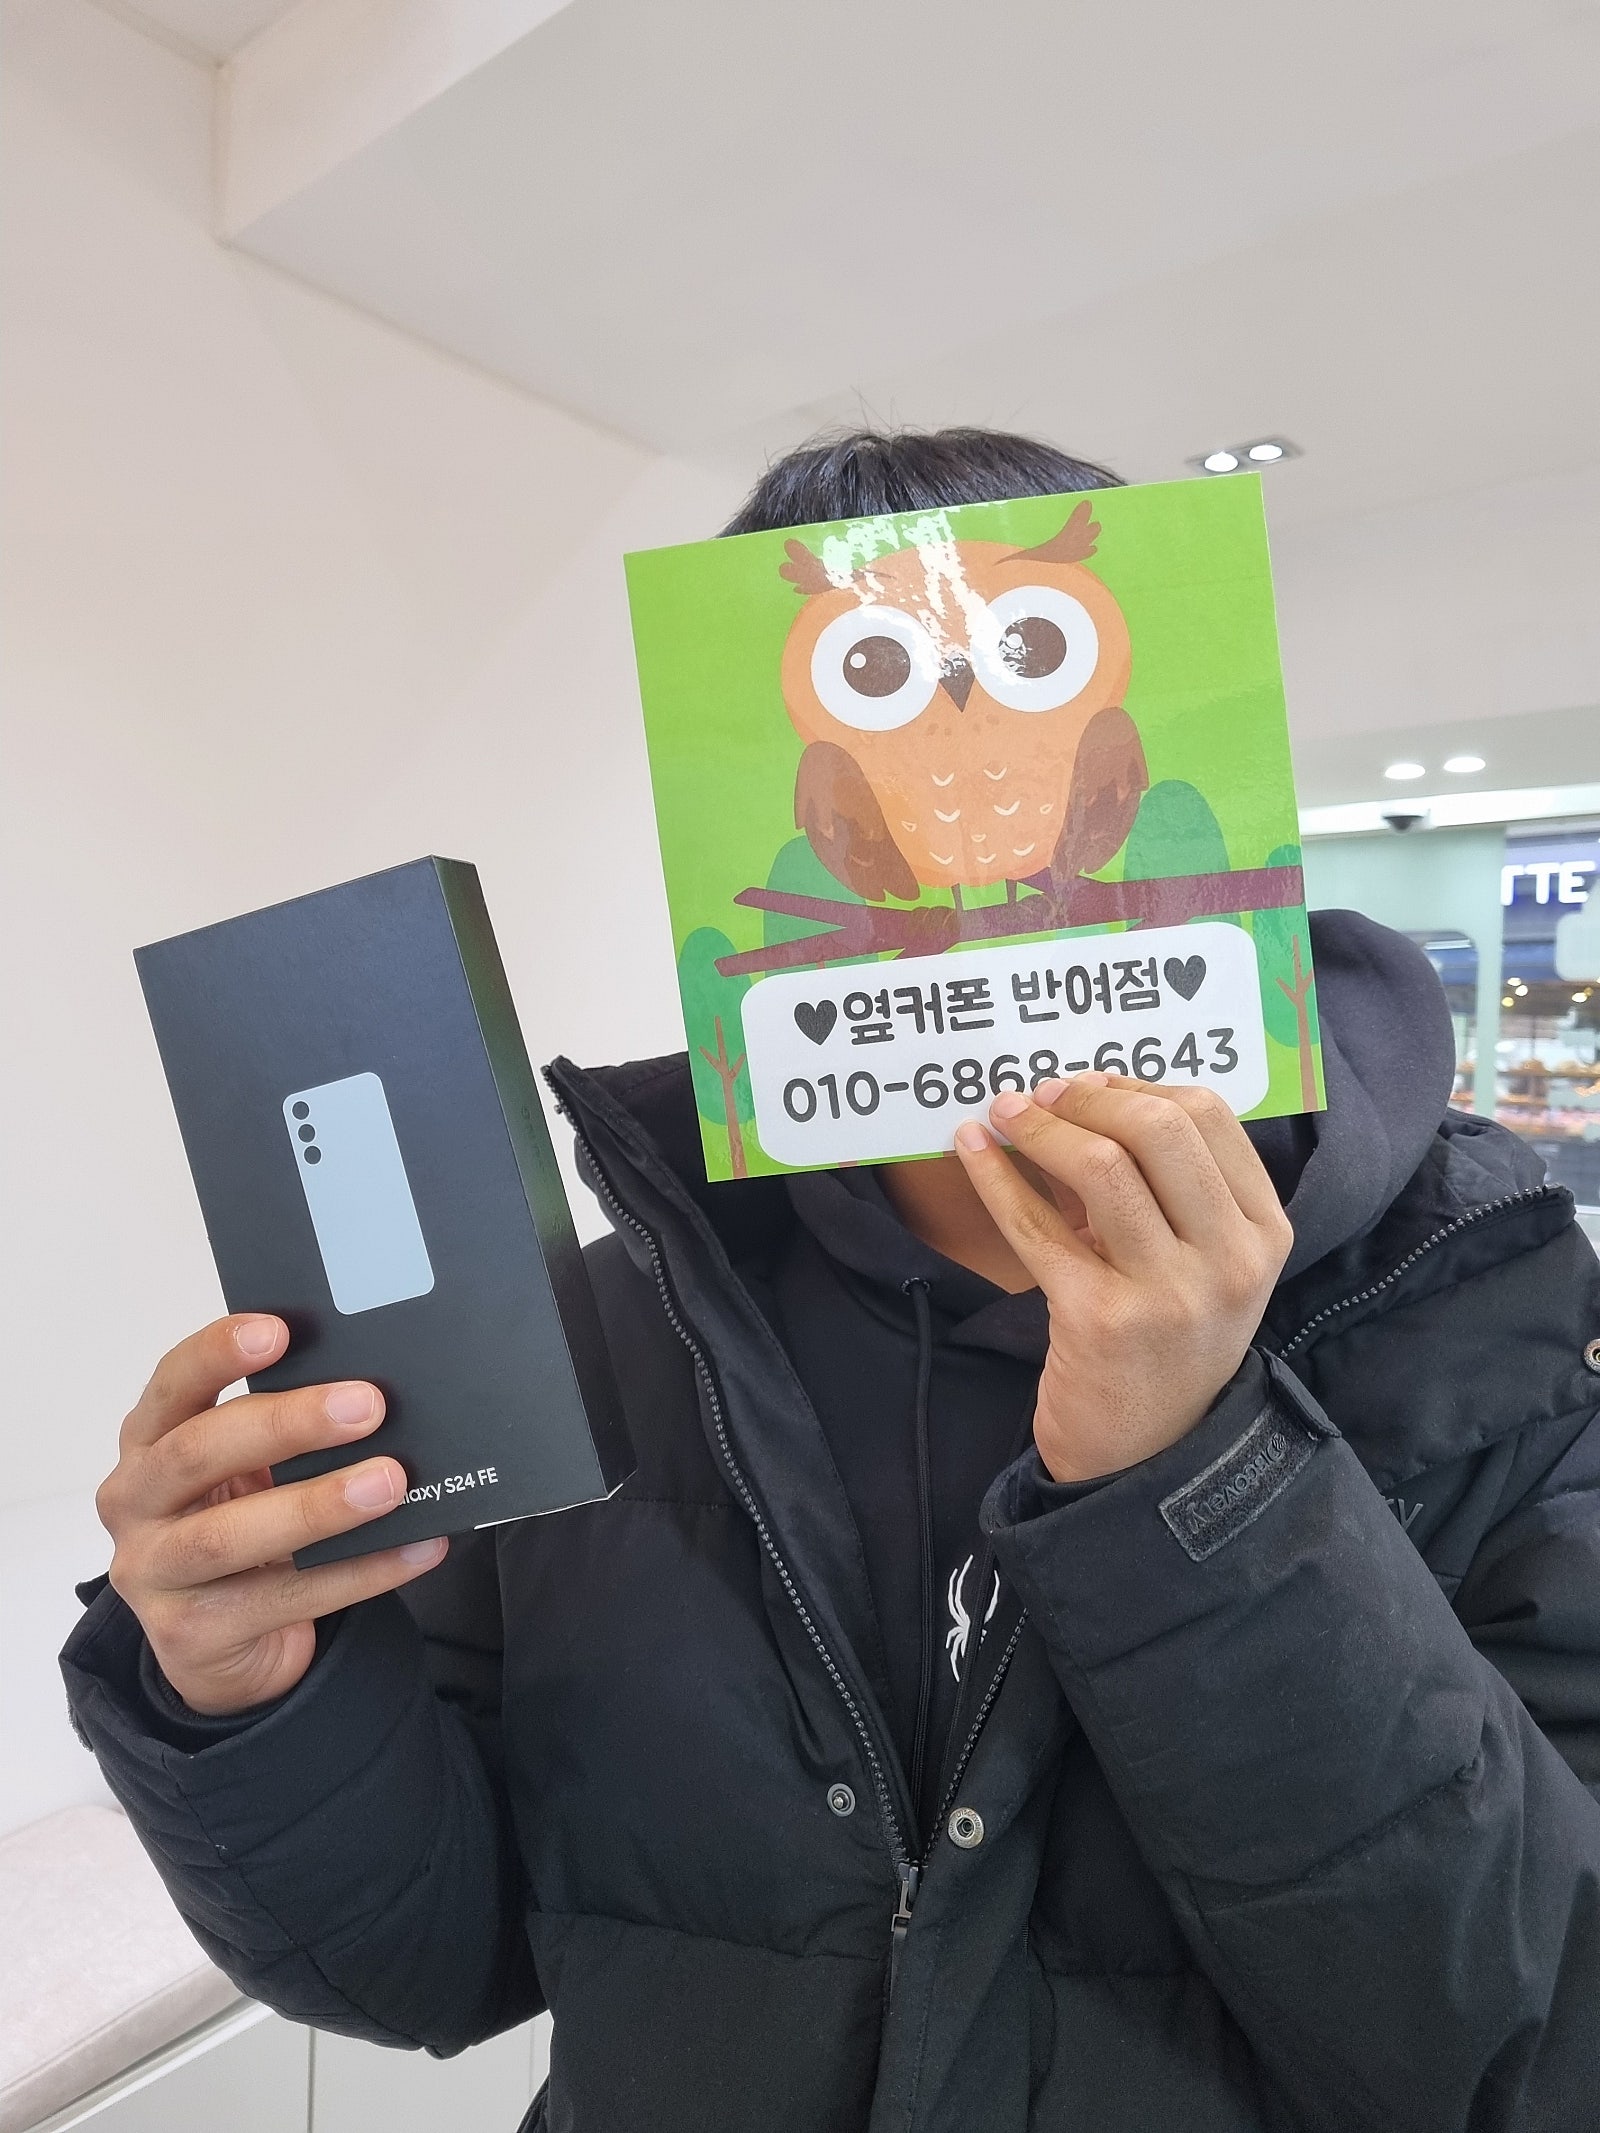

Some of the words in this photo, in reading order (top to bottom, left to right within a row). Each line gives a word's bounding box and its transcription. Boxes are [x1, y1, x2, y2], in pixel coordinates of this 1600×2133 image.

[842, 977, 995, 1046] 옆커폰
[1011, 956, 1161, 1024] 반여점
[782, 1027, 1239, 1123] 010-6868-6643
[400, 1482, 442, 1505] laxy
[443, 1472, 476, 1494] S24
[476, 1466, 499, 1486] FE
